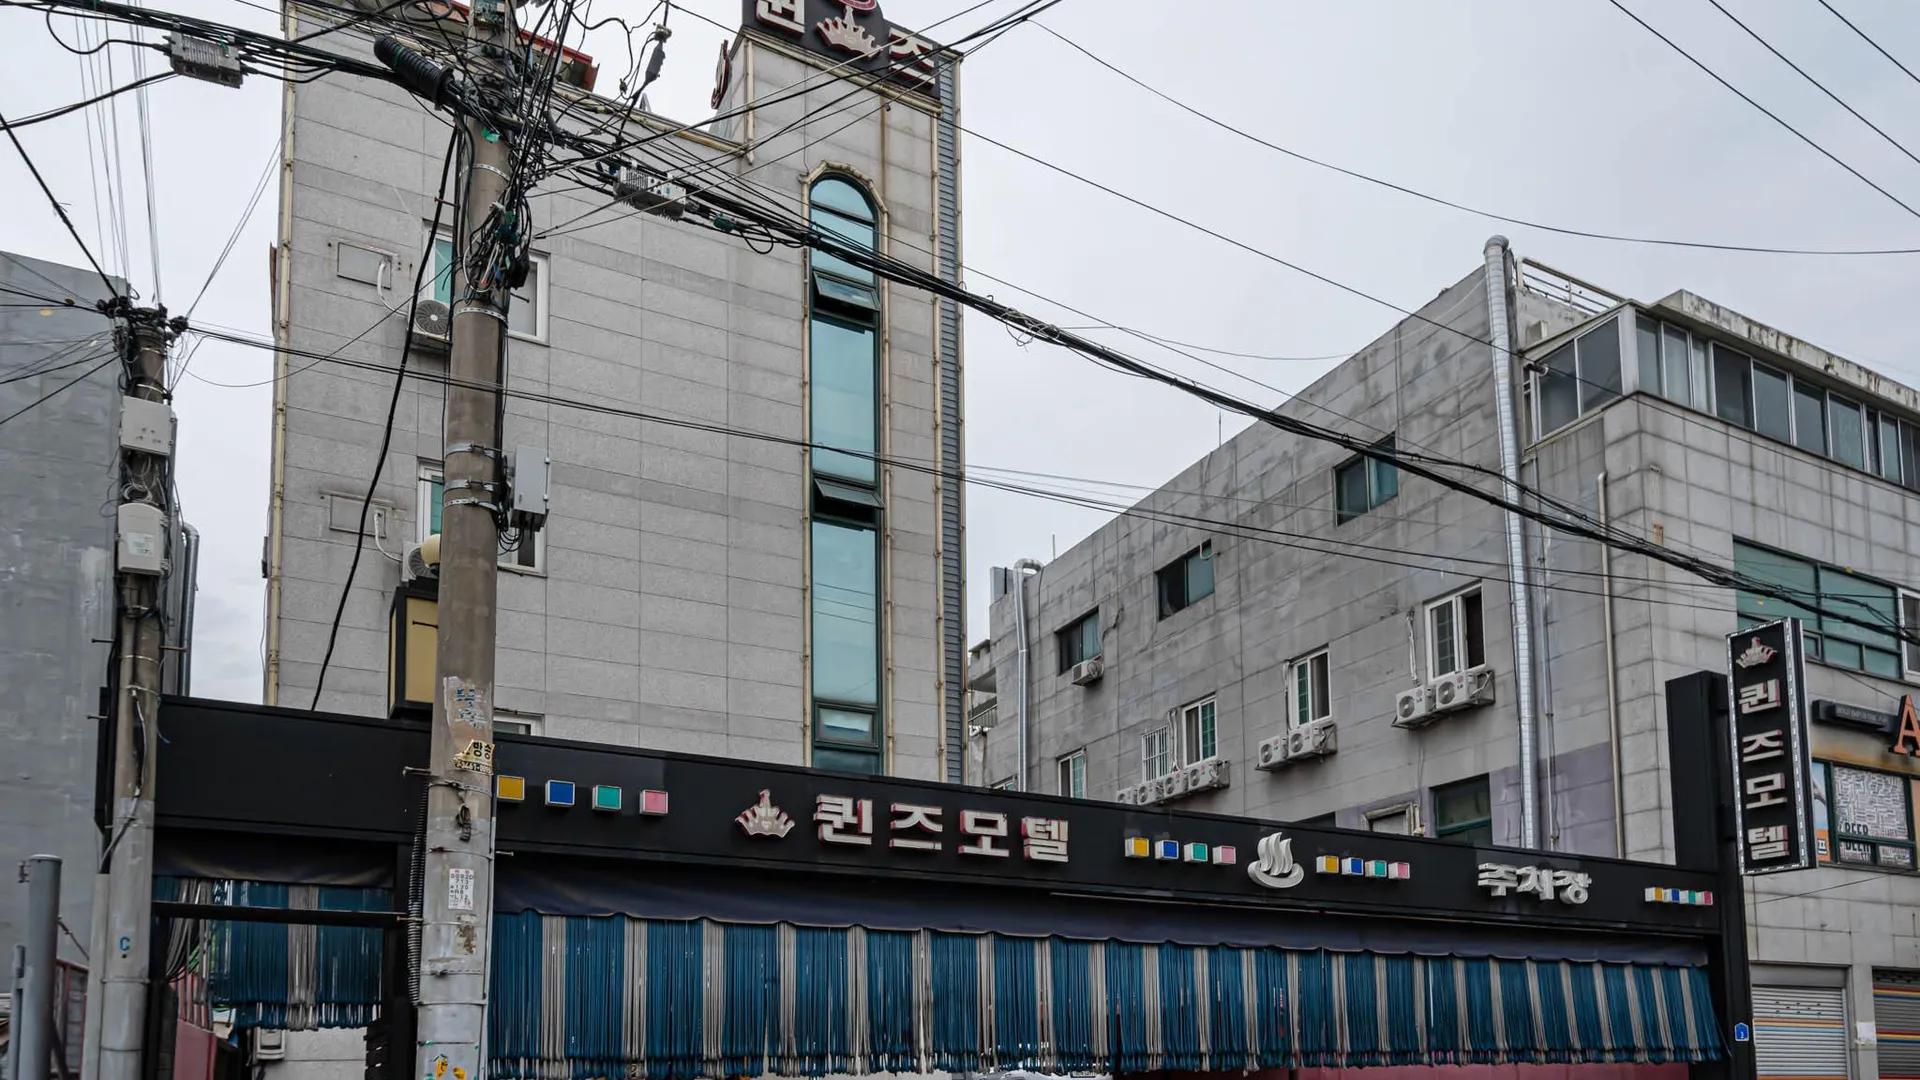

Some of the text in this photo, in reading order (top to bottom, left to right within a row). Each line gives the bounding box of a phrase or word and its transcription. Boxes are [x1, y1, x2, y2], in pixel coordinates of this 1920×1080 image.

[1738, 679, 1790, 861] 퀸즈모텔
[813, 792, 1070, 863] 퀸즈모텔
[1477, 862, 1593, 905] 주차장
[119, 936, 131, 952] C
